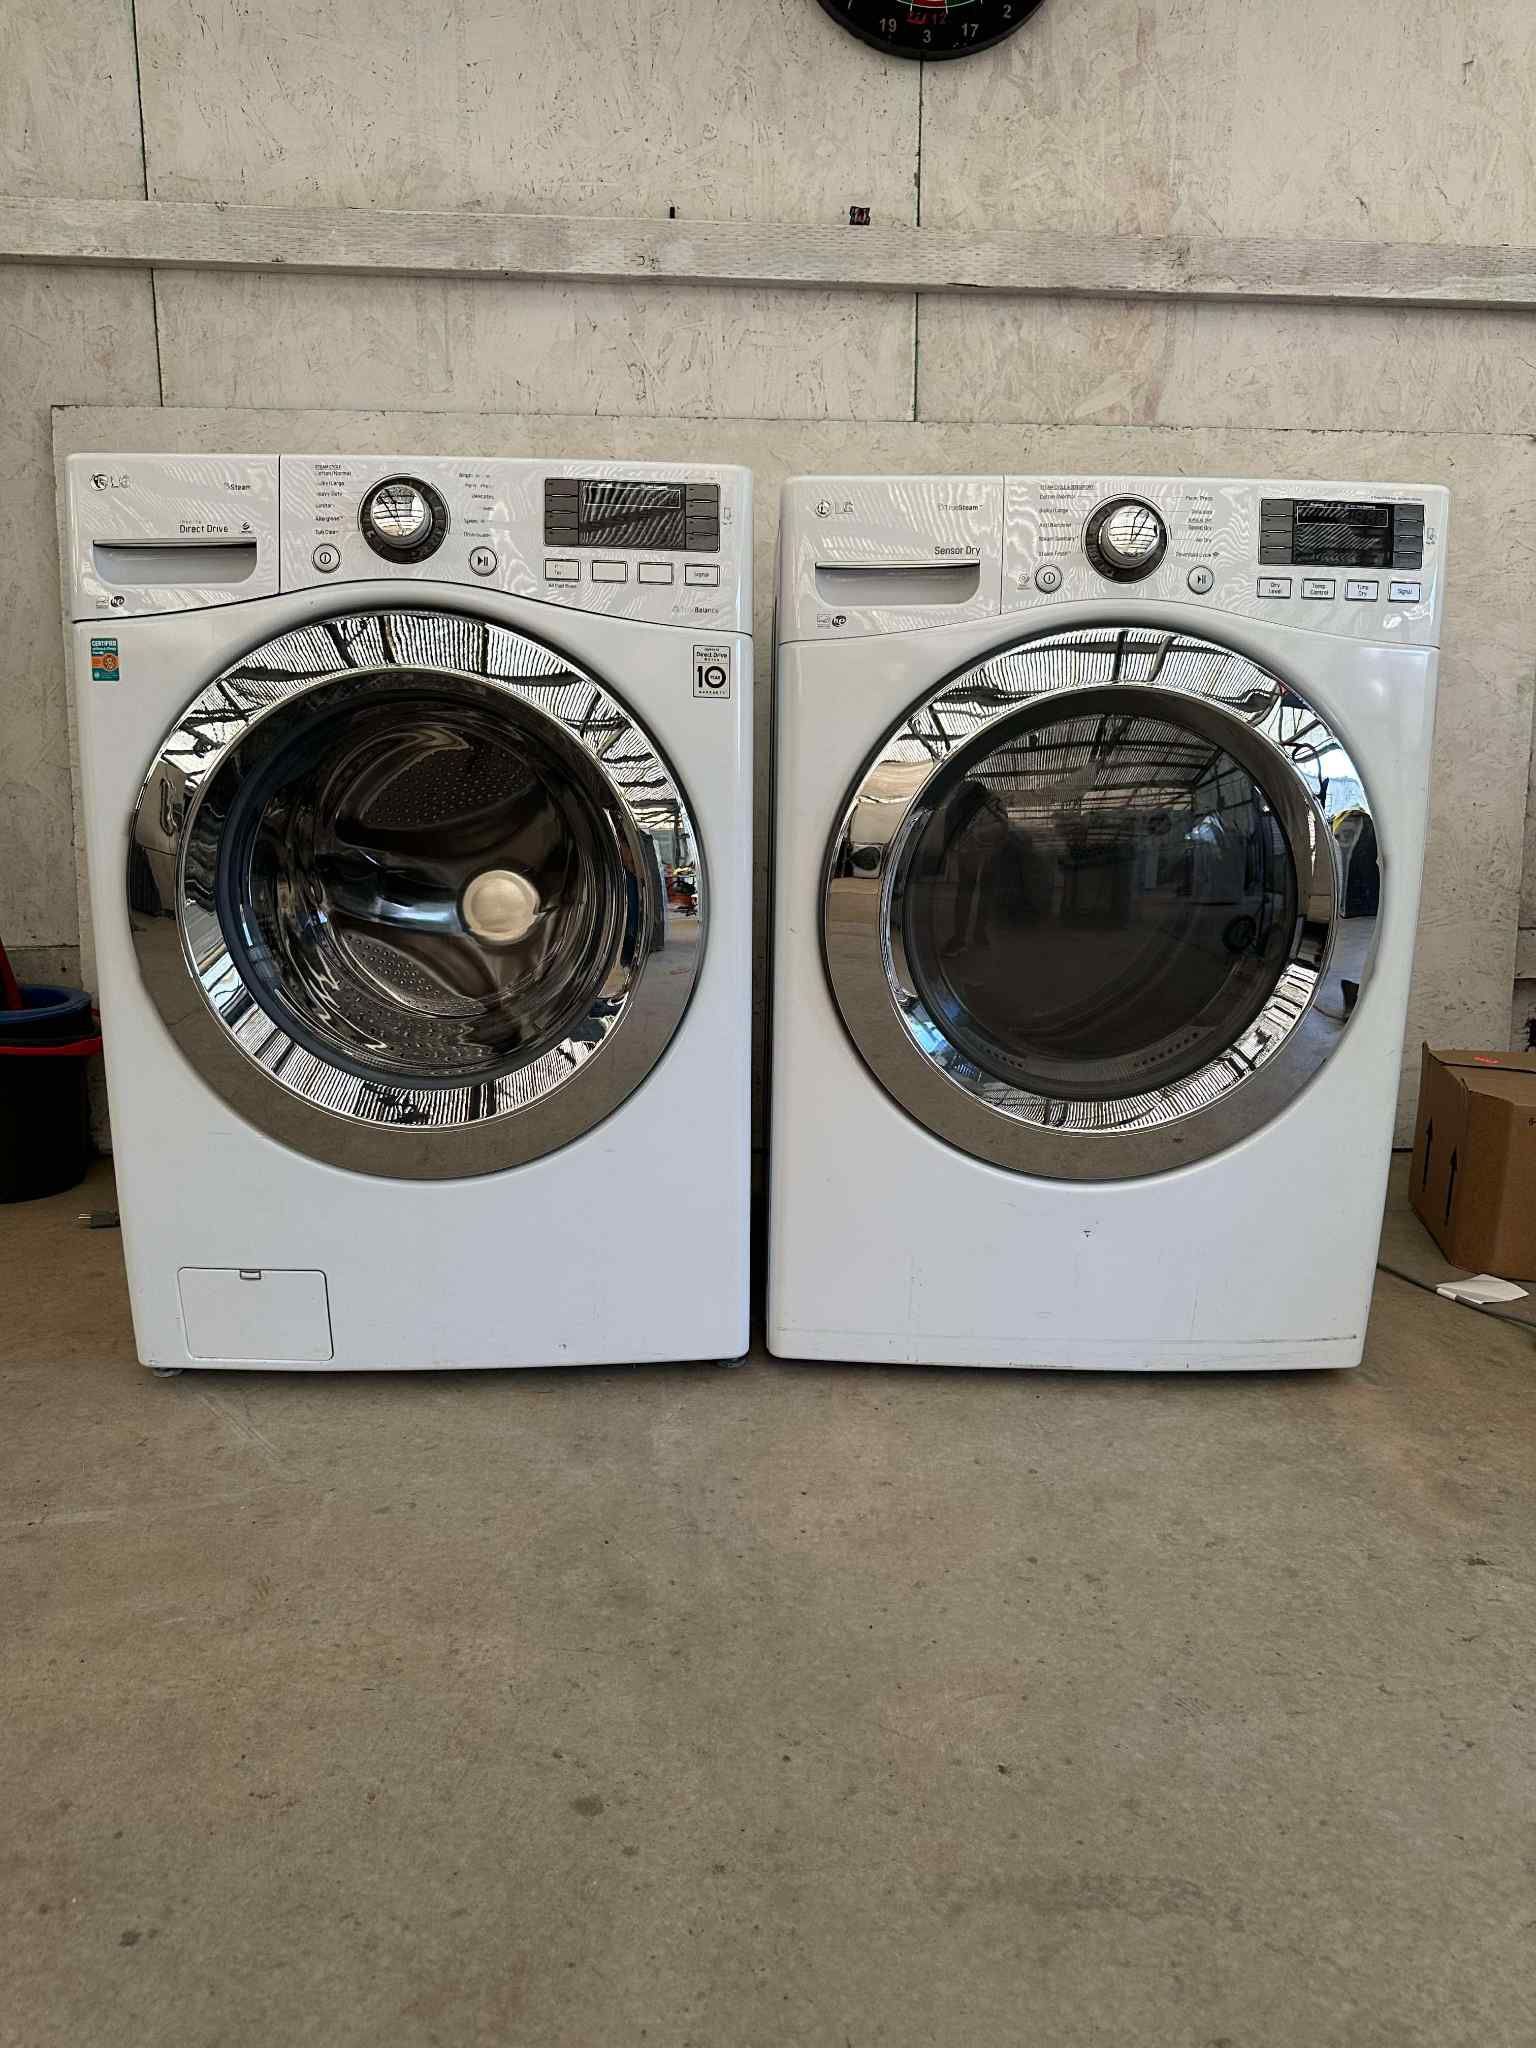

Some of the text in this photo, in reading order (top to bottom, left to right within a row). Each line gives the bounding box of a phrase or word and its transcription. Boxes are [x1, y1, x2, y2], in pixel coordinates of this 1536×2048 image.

[1003, 4, 1013, 19] 2
[880, 18, 897, 33] 19
[961, 23, 979, 38] 17
[922, 29, 932, 44] 3
[179, 524, 230, 534] Direct Drive
[934, 545, 981, 557] Sensor Dry
[697, 665, 727, 689] 10
